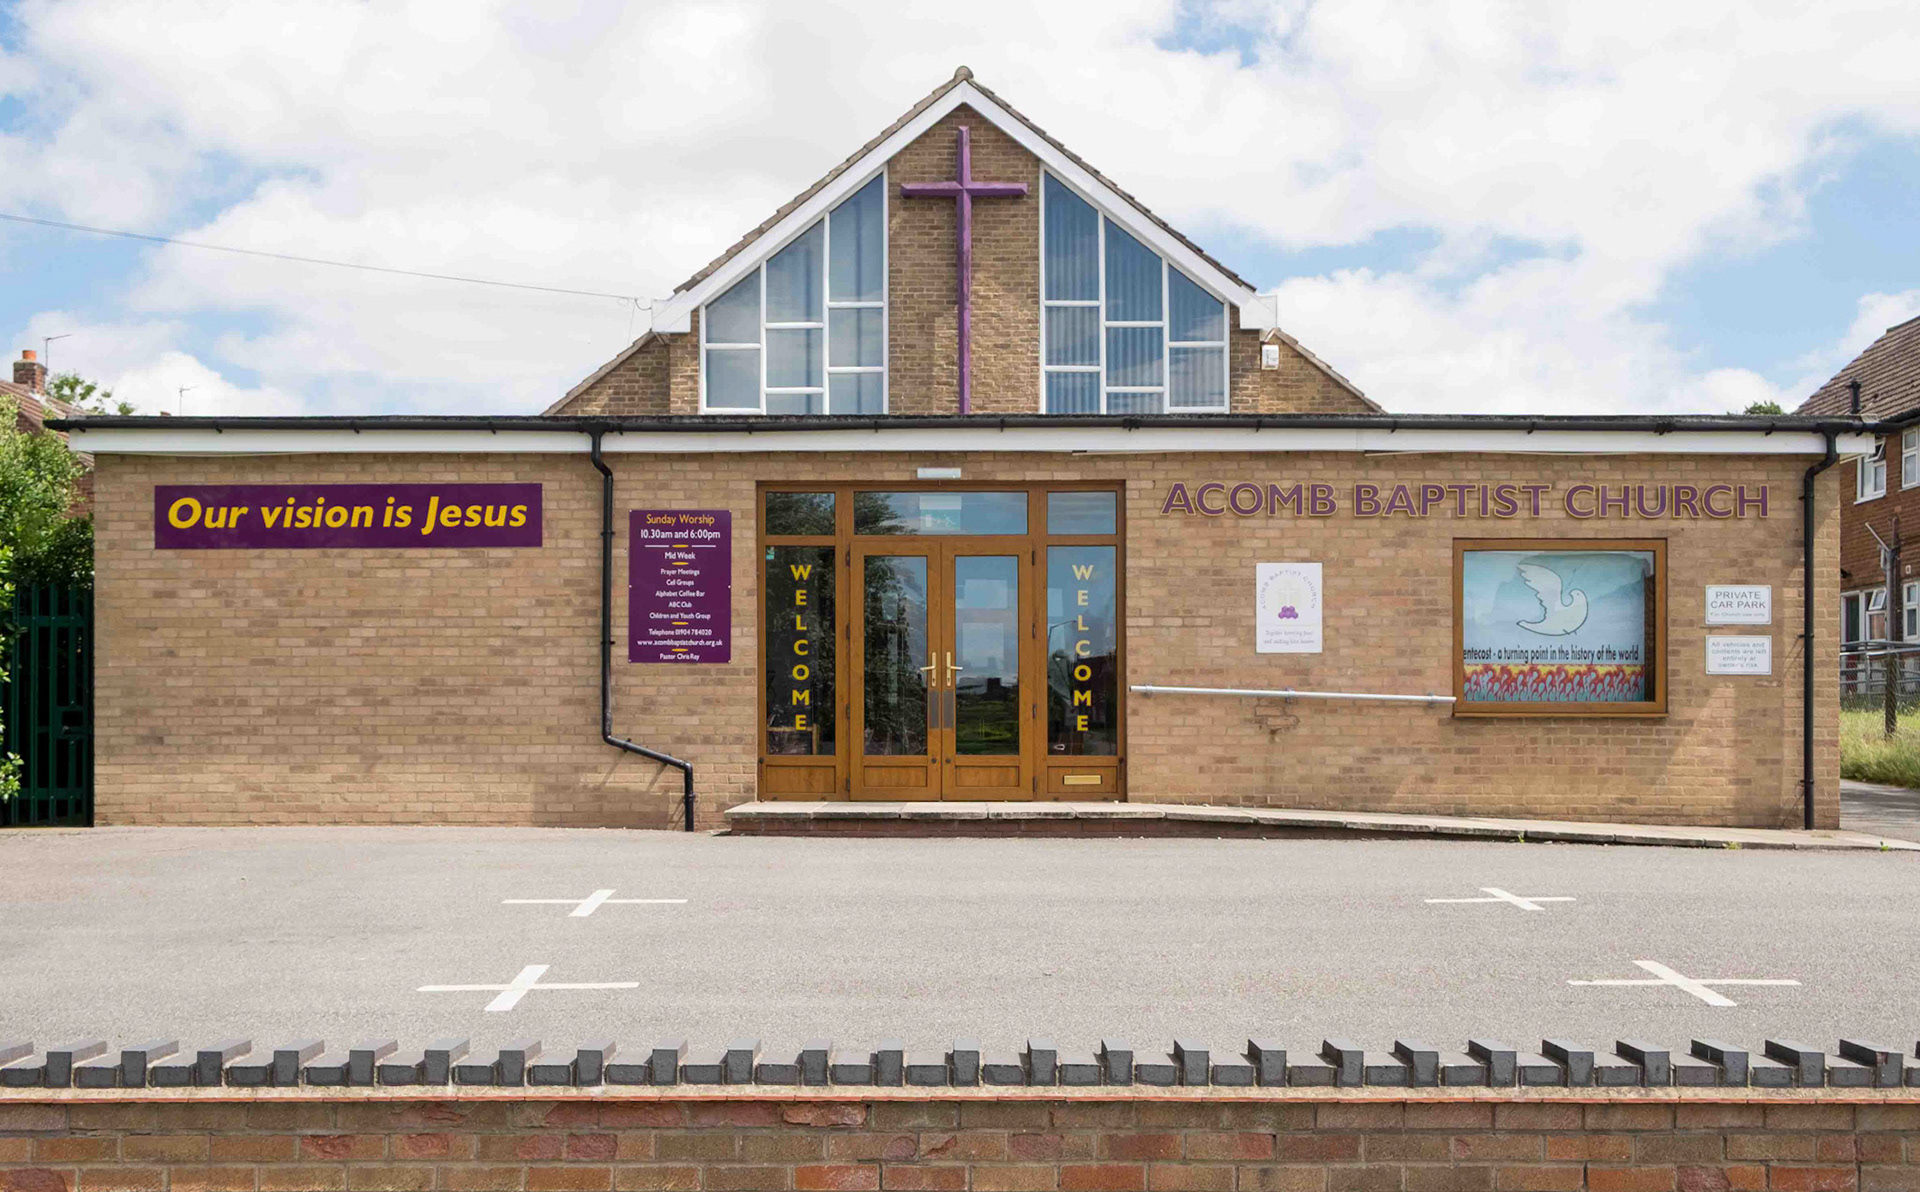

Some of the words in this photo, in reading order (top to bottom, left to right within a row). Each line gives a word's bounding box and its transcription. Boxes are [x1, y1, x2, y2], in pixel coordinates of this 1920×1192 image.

[1160, 482, 1339, 519] ACOMB
[1352, 482, 1552, 519] BAPTIST
[1564, 484, 1769, 520] CHURCH
[167, 496, 249, 529] Our
[259, 496, 374, 529] vision
[382, 496, 413, 528] is
[420, 496, 528, 536] Jesus
[646, 513, 677, 526] Sunday
[679, 514, 715, 526] Worship
[640, 529, 673, 539] 10.30am
[674, 529, 689, 539] and
[690, 529, 721, 541] 6:00pm
[664, 552, 676, 560] Mid
[677, 552, 696, 560] Week
[660, 568, 677, 576] Prayer
[677, 568, 700, 577] Meetings
[676, 579, 695, 587] Groups
[655, 590, 678, 598] Alphabet
[1715, 591, 1761, 600] PRIVATE
[1710, 600, 1734, 609] CAR
[1737, 600, 1766, 609] PARK
[649, 628, 675, 636] Telephone
[637, 639, 723, 648] www.acombbaptistchurch.org.uk
[790, 564, 812, 731] WELCOME
[1072, 564, 1094, 732] WELCOME
[1503, 645, 1528, 663] turning
[1531, 645, 1549, 664] point
[1550, 646, 1557, 660] in
[1558, 646, 1570, 660] the
[1571, 646, 1595, 664] history
[1597, 646, 1605, 660] of
[1605, 646, 1617, 660] the
[1618, 646, 1639, 660] world
